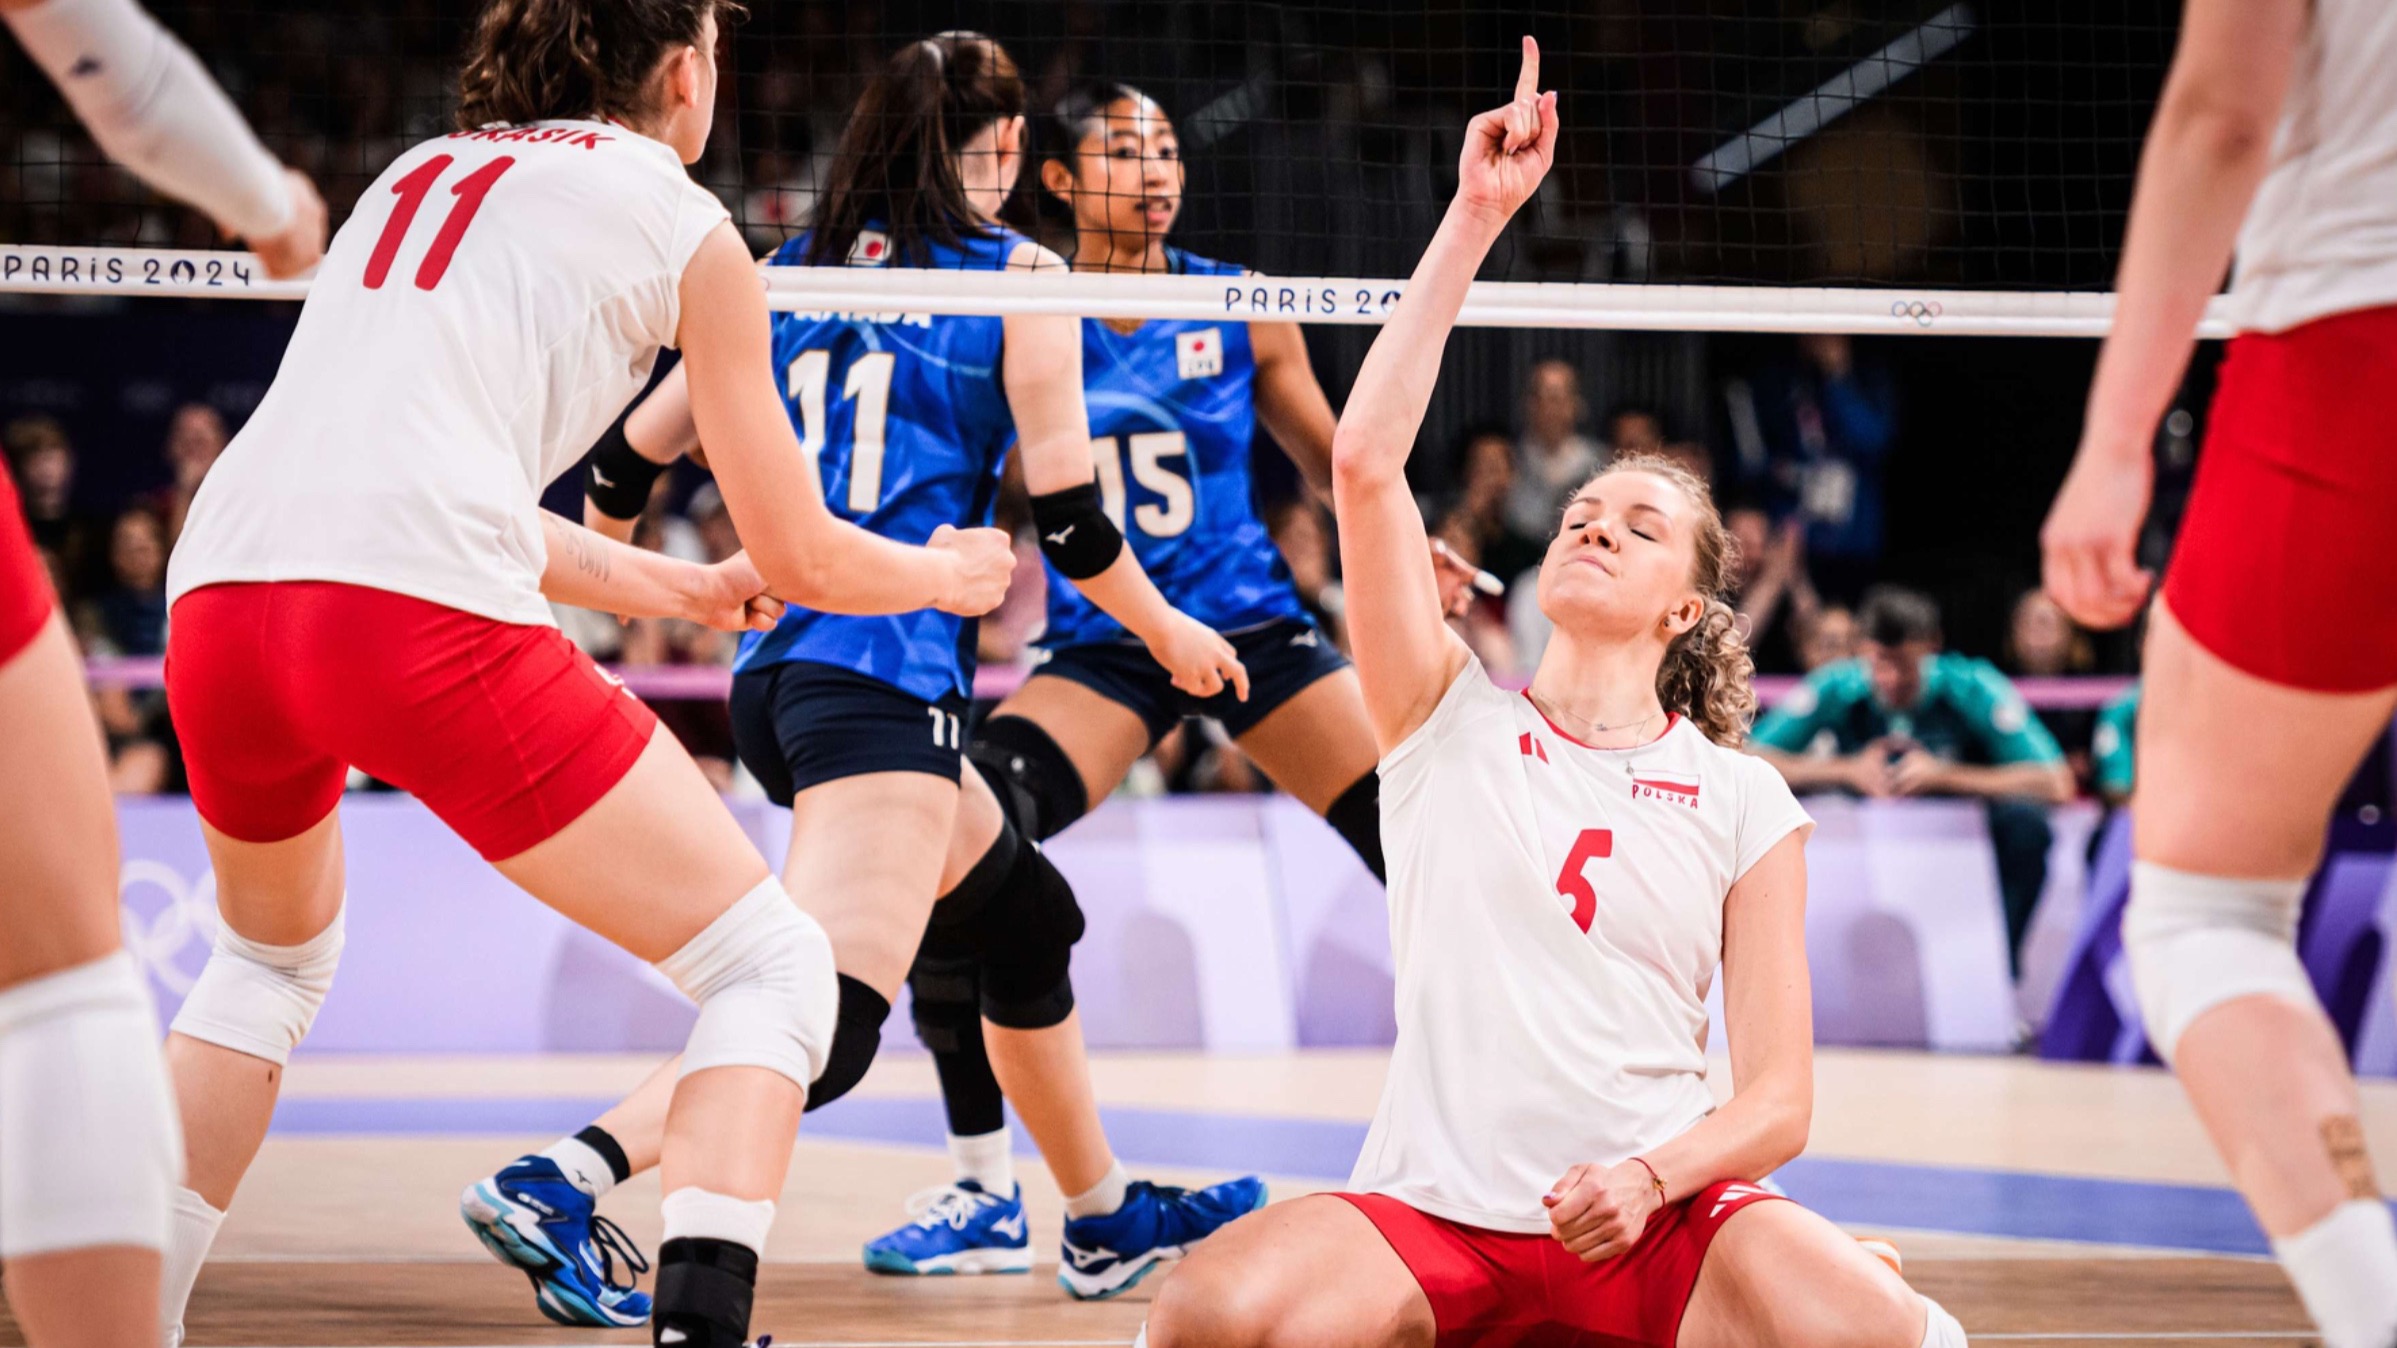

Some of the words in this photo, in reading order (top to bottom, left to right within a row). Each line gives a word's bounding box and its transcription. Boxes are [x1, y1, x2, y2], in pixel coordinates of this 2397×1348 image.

[144, 258, 249, 286] 2024
[363, 154, 515, 291] 11
[788, 349, 896, 513] 11
[1091, 430, 1195, 537] 15
[927, 706, 960, 750] 11
[1632, 784, 1698, 810] POLSKA
[1556, 828, 1613, 935] 5
